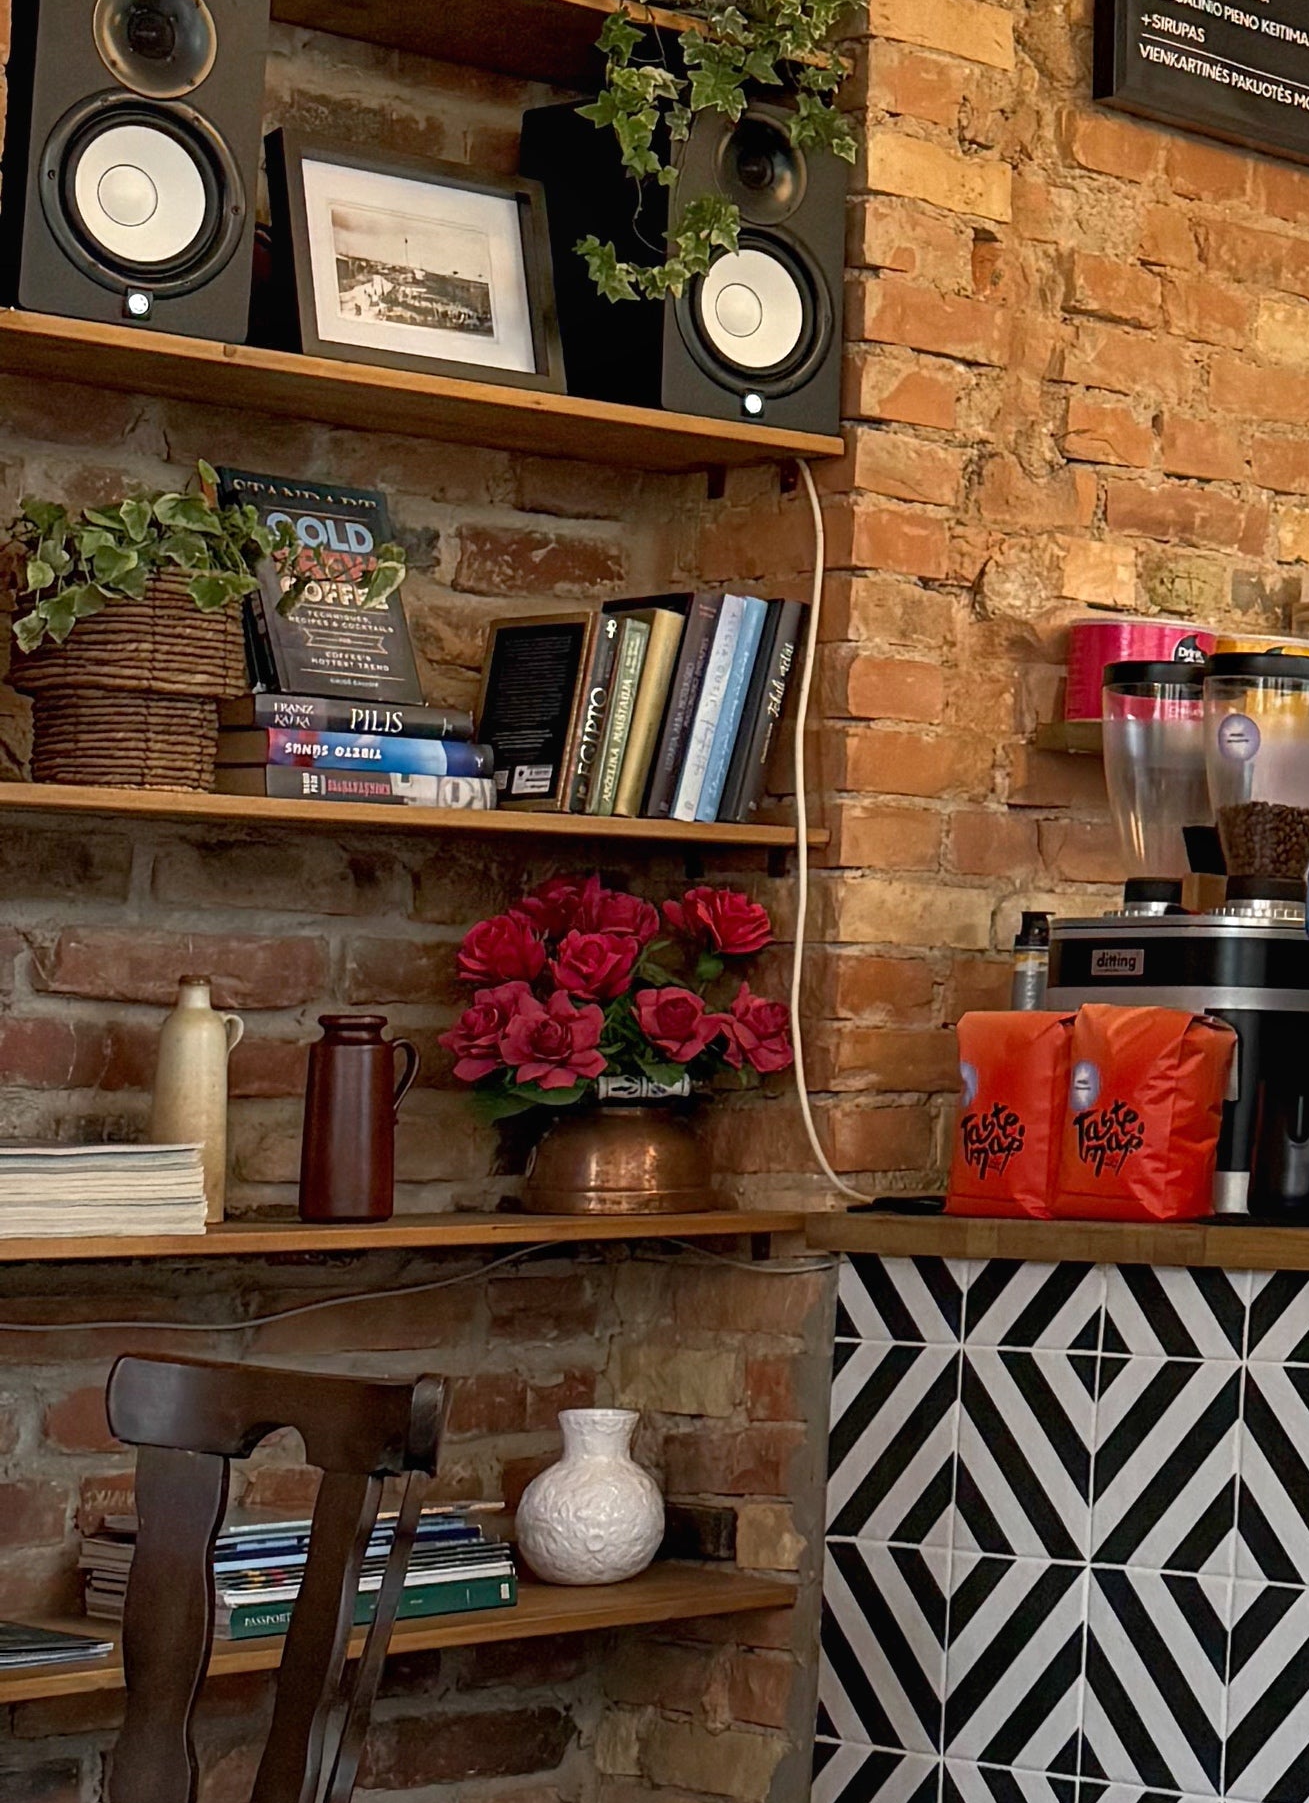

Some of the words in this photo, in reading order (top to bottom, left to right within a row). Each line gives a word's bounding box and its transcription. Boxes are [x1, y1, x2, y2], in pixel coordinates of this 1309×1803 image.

[1141, 13, 1206, 43] +SIRUPAS
[1224, 5, 1259, 30] PIENO
[1138, 43, 1230, 84] VIENKARTINĖS
[350, 708, 403, 733] PILIS
[1097, 951, 1137, 972] ditting
